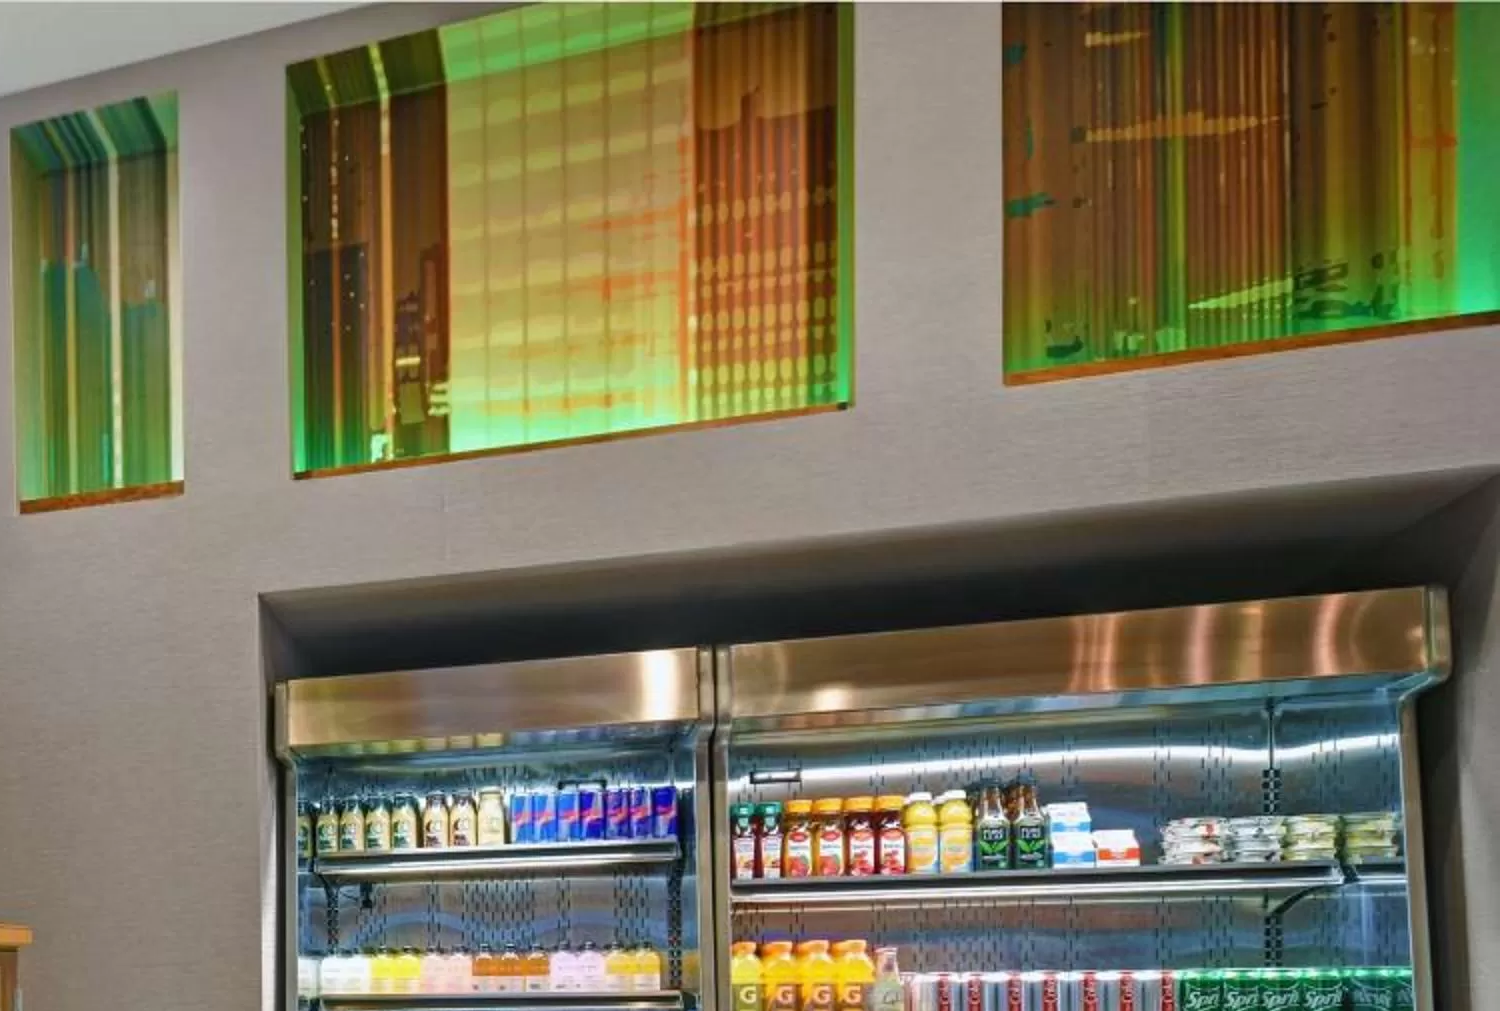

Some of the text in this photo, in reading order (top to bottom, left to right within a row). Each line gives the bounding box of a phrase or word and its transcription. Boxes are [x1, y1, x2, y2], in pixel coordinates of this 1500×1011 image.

[740, 986, 757, 1004] G
[777, 986, 793, 1004] G
[813, 986, 831, 1005] G
[844, 986, 861, 1004] G
